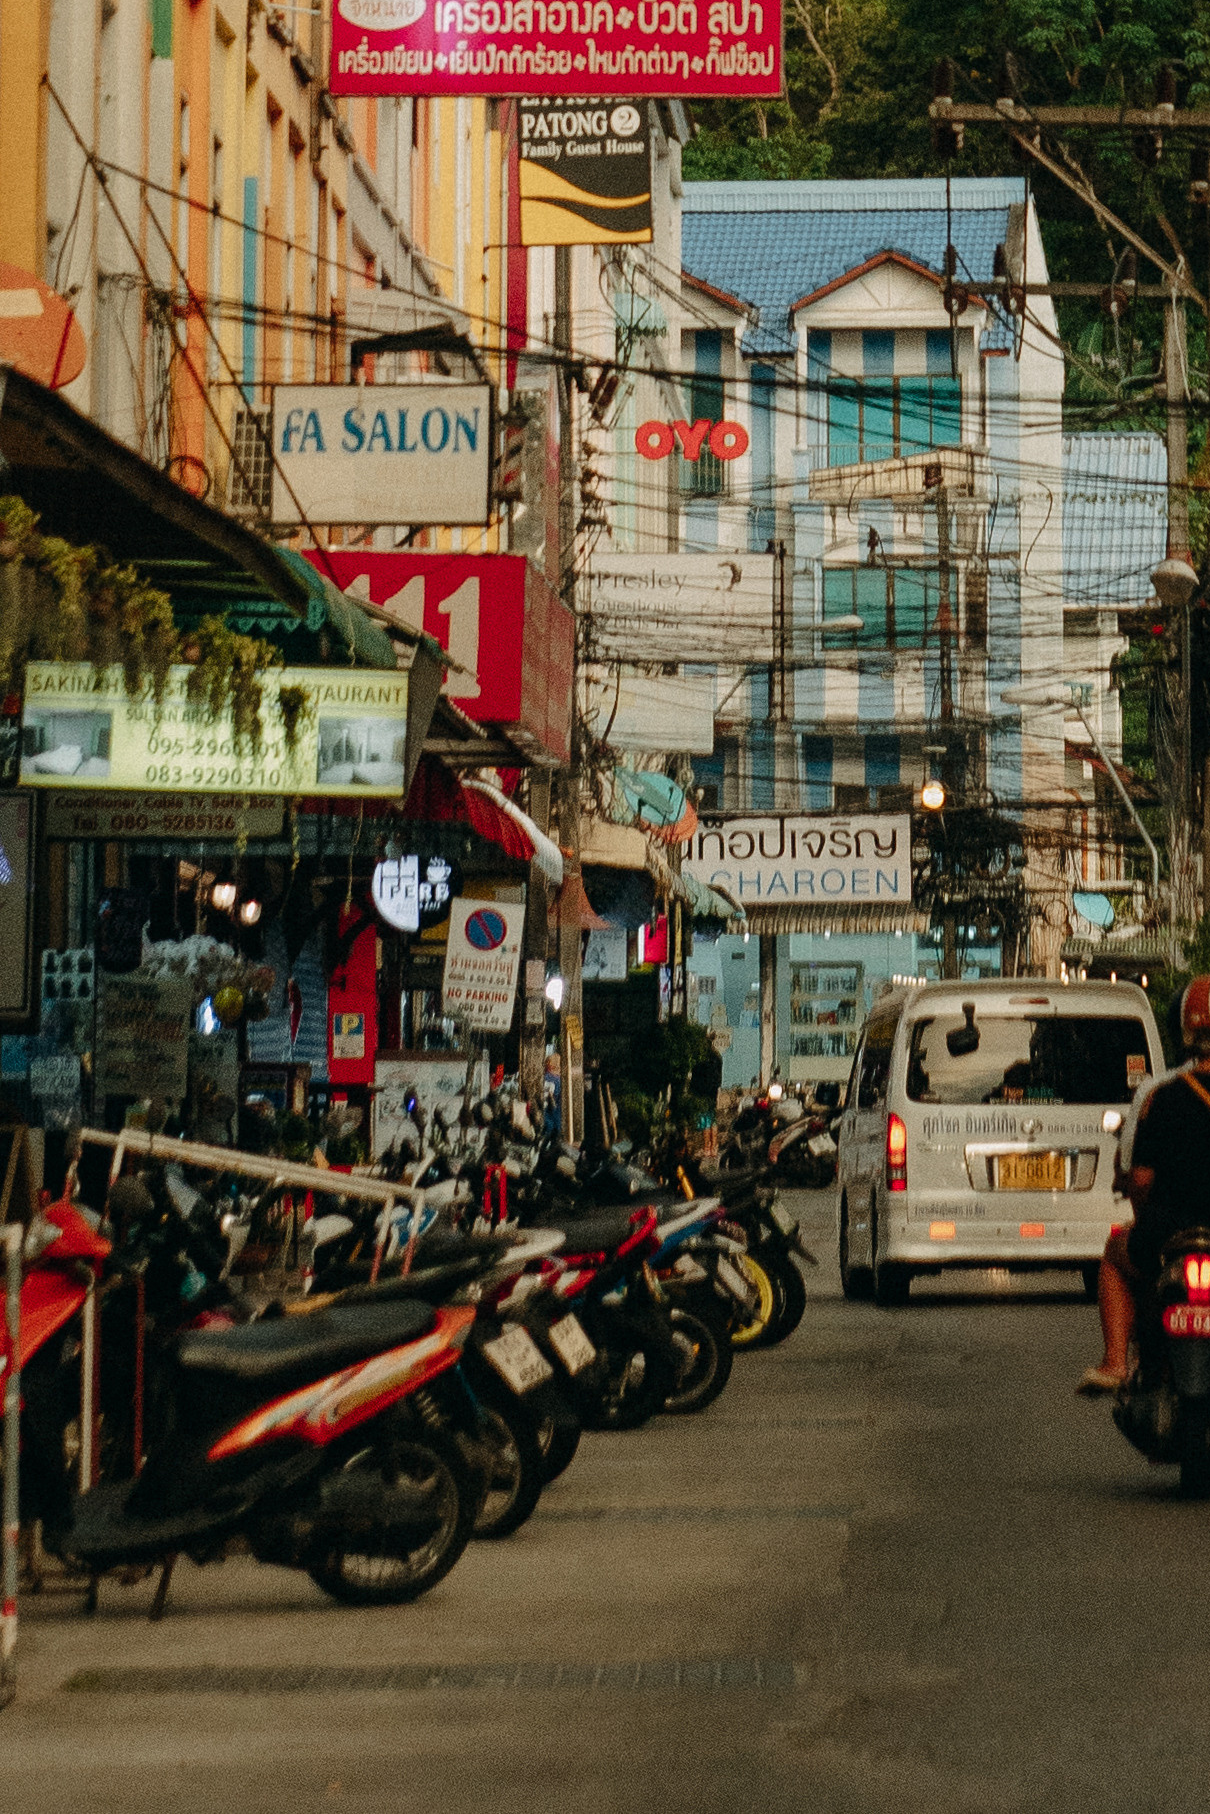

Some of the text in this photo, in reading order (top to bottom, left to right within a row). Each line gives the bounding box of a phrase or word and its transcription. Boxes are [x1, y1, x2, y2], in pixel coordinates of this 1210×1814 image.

[521, 110, 608, 138] PATONG
[521, 138, 645, 161] Family Guest House
[341, 406, 480, 454] SALON
[635, 418, 749, 462] OYO
[597, 569, 688, 597] Presley
[145, 764, 282, 787] 083-9290310
[709, 868, 899, 895] CHAROEN
[447, 988, 508, 1003] NO PARKING
